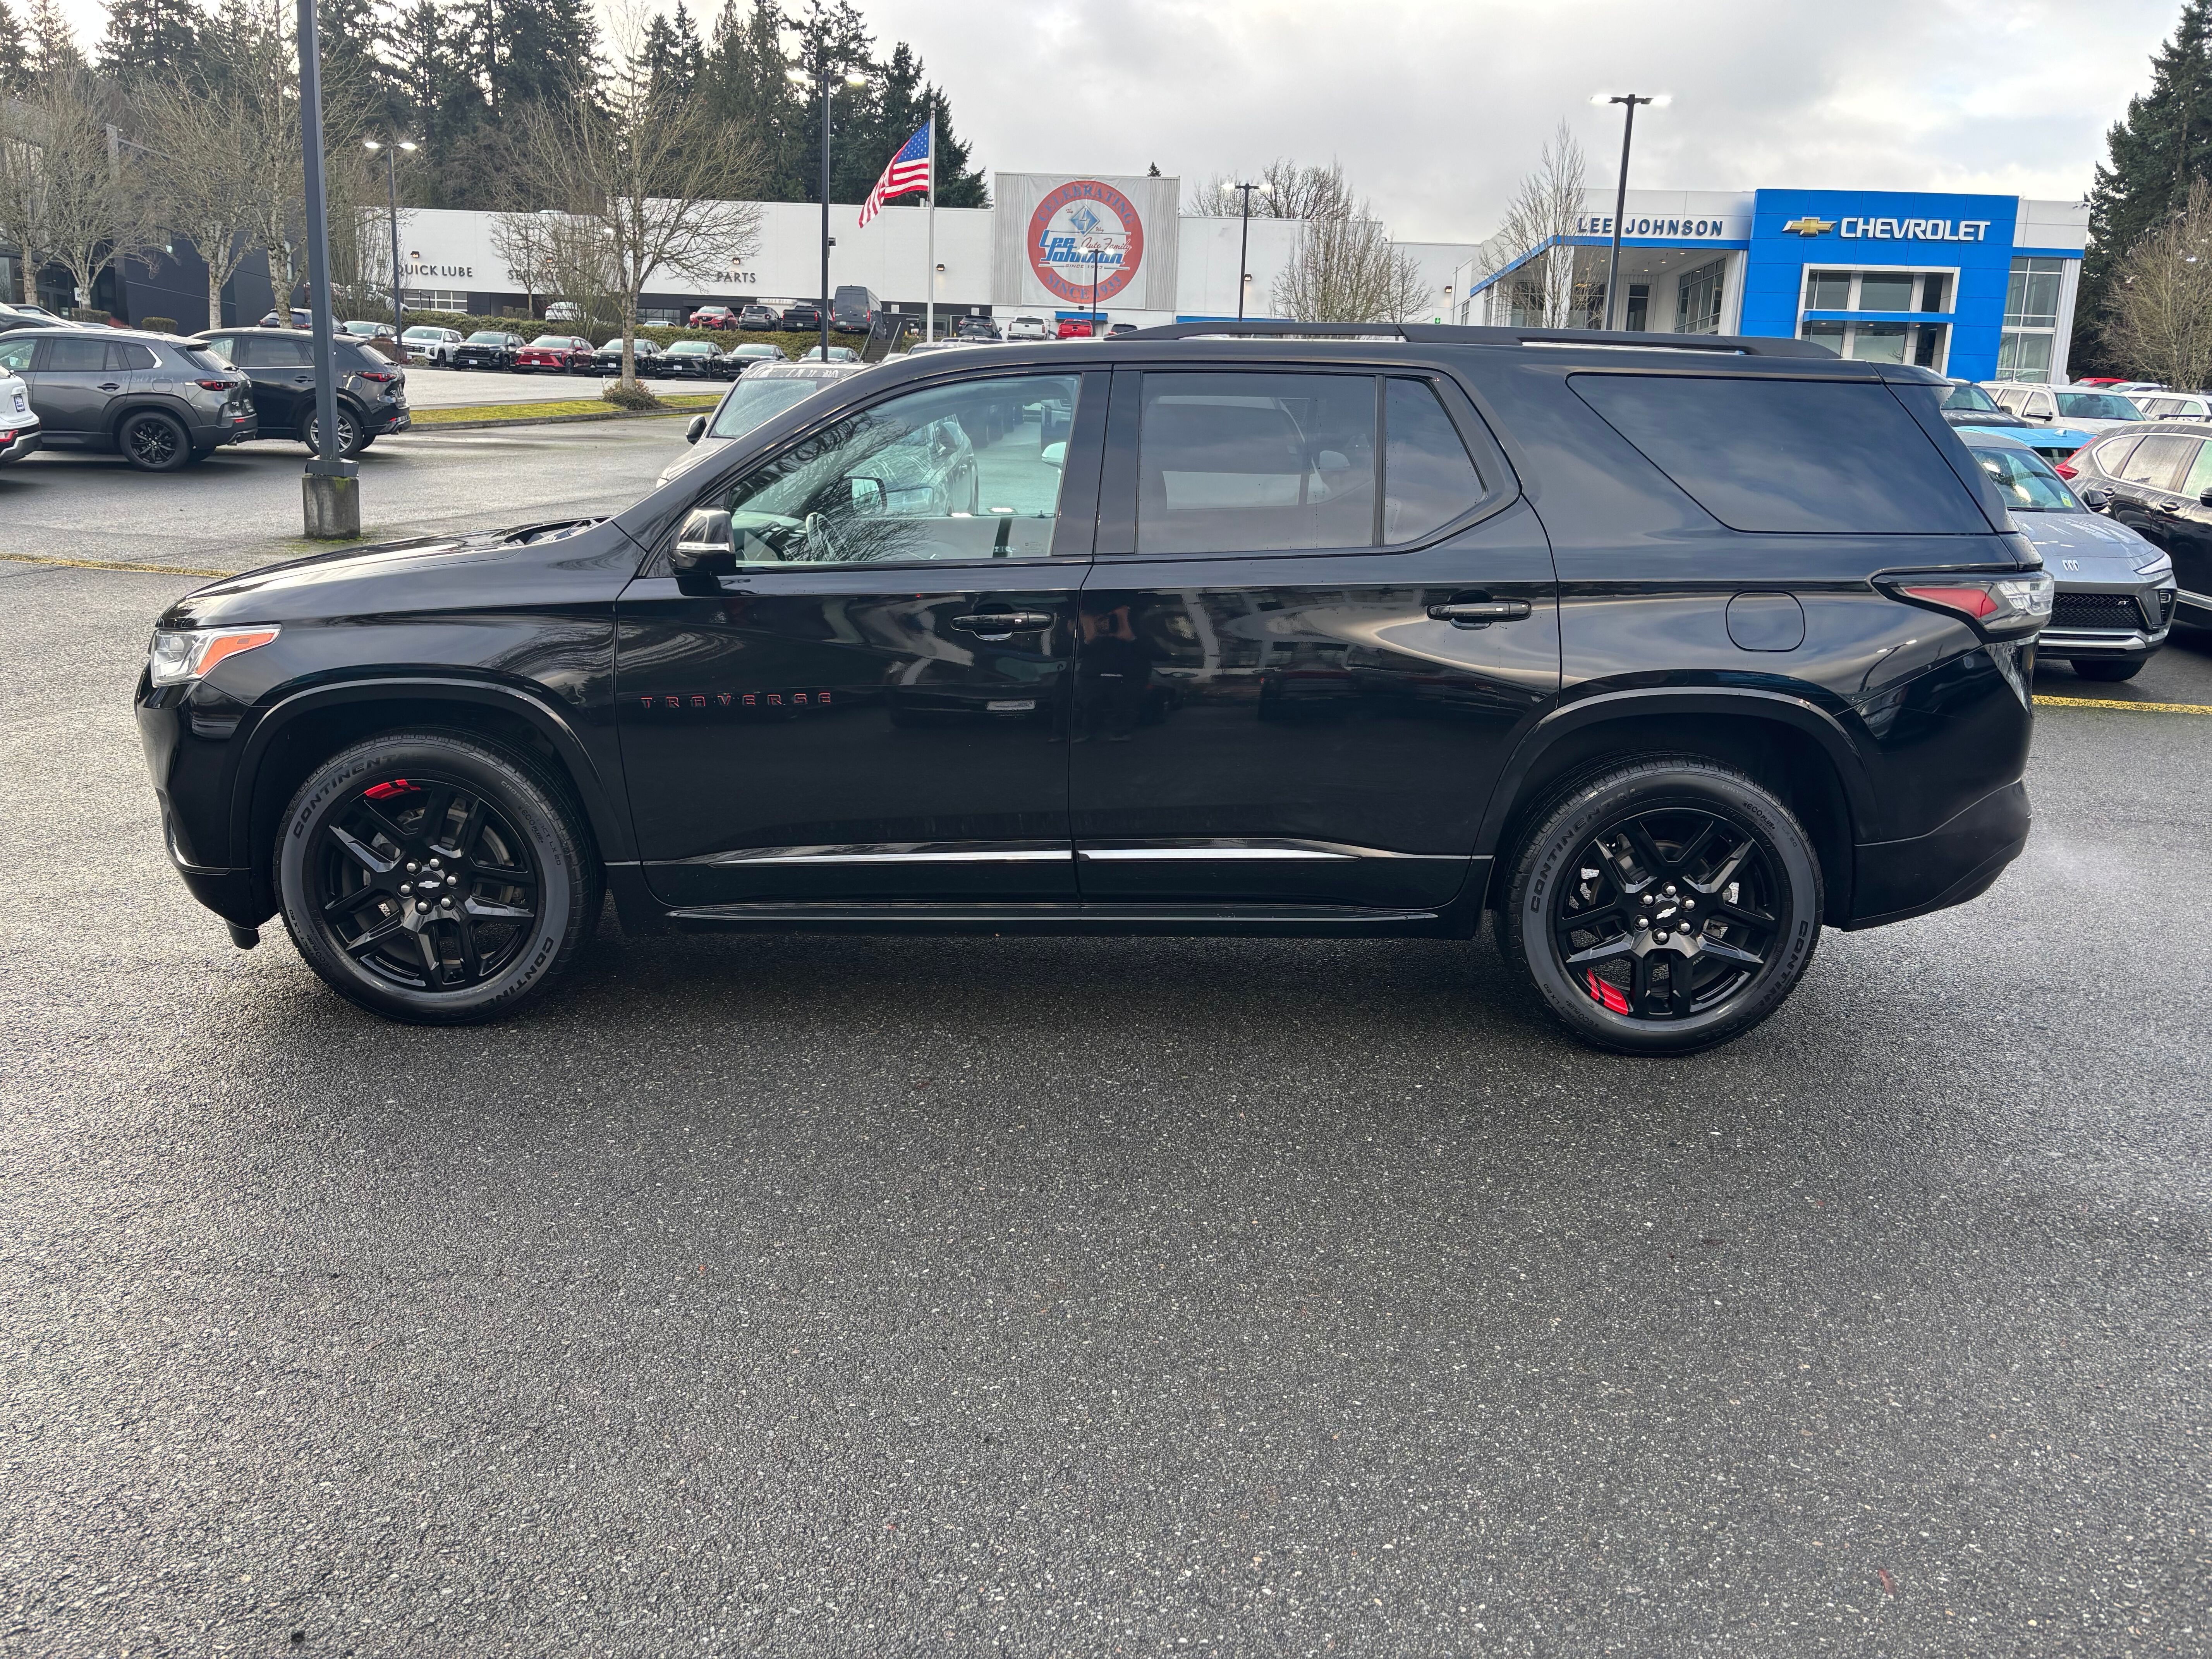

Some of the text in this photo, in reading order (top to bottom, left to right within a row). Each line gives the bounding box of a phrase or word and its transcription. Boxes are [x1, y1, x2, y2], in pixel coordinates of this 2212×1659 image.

[1038, 184, 1135, 224] CELEBRATING
[1578, 217, 1723, 236] LEE JOHNSON
[1841, 218, 1991, 241] CHEVROLET
[1039, 230, 1132, 255] Lee Auto Family
[1041, 245, 1125, 264] Johnson
[441, 266, 473, 277] LUBE
[717, 271, 756, 283] PARTS
[1046, 273, 1089, 299] SINCE
[641, 692, 831, 708] TRAVERSE
[1531, 788, 1644, 913] CONTINENTAL
